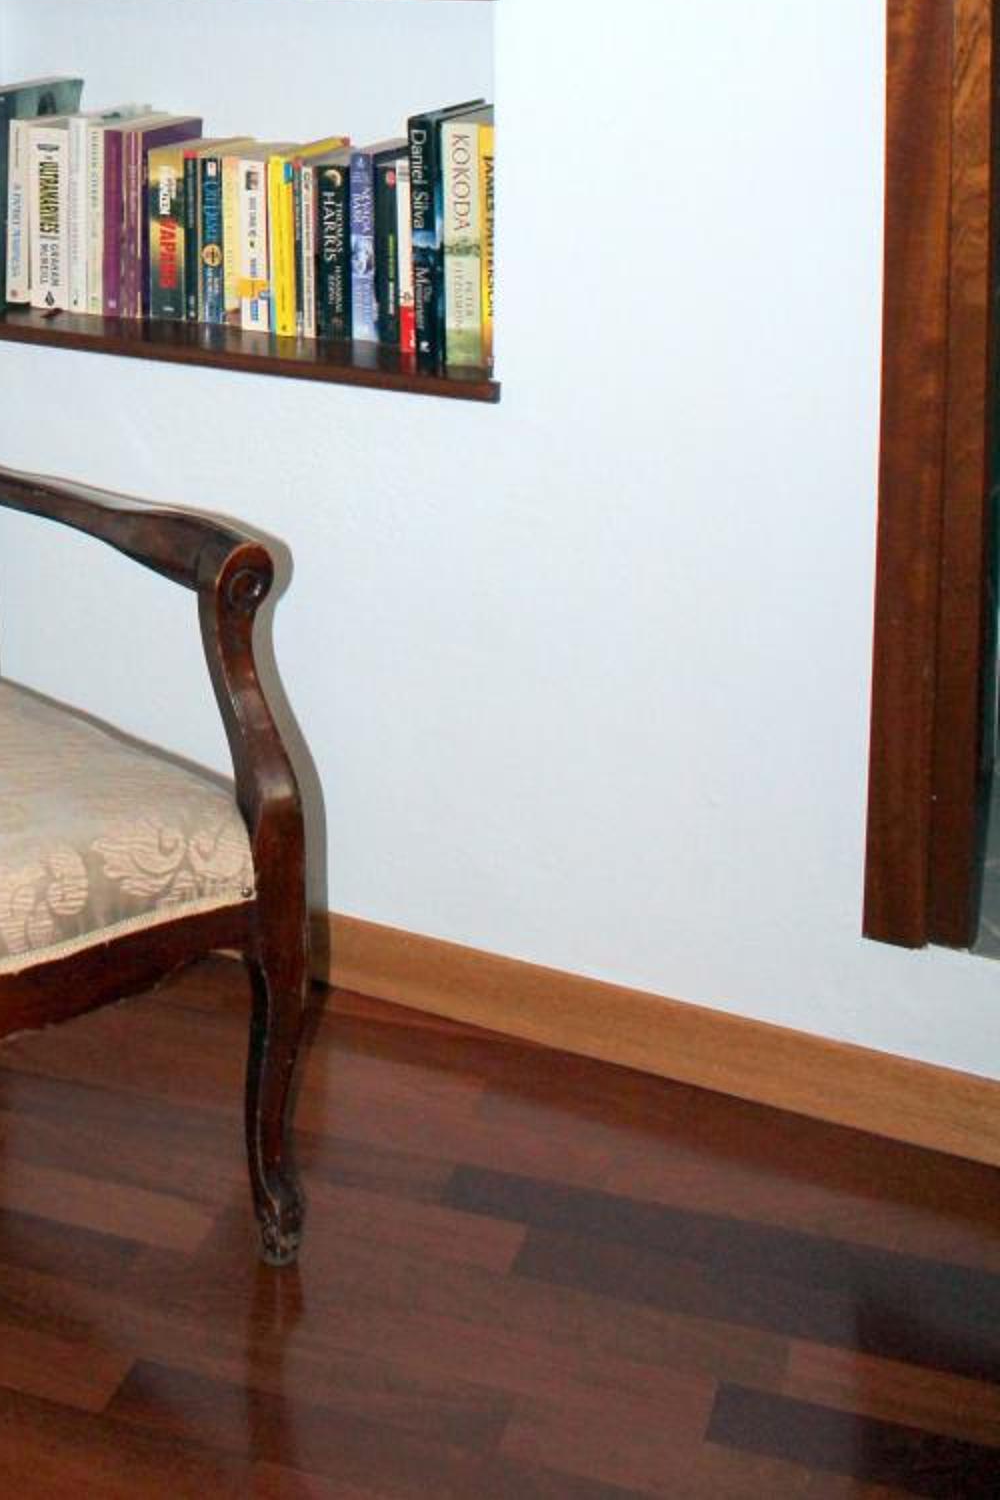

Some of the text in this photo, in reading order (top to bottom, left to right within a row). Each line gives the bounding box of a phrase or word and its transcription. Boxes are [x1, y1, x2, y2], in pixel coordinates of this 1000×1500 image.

[39, 161, 60, 234] ULTRAMARINES
[353, 193, 362, 224] BARR
[362, 187, 370, 233] NEVADA
[410, 129, 428, 229] Daniel Silva
[451, 133, 471, 232] KOKODA
[322, 191, 335, 262] HARRIS
[50, 243, 59, 287] GRAHAM
[414, 267, 429, 330] Messenger
